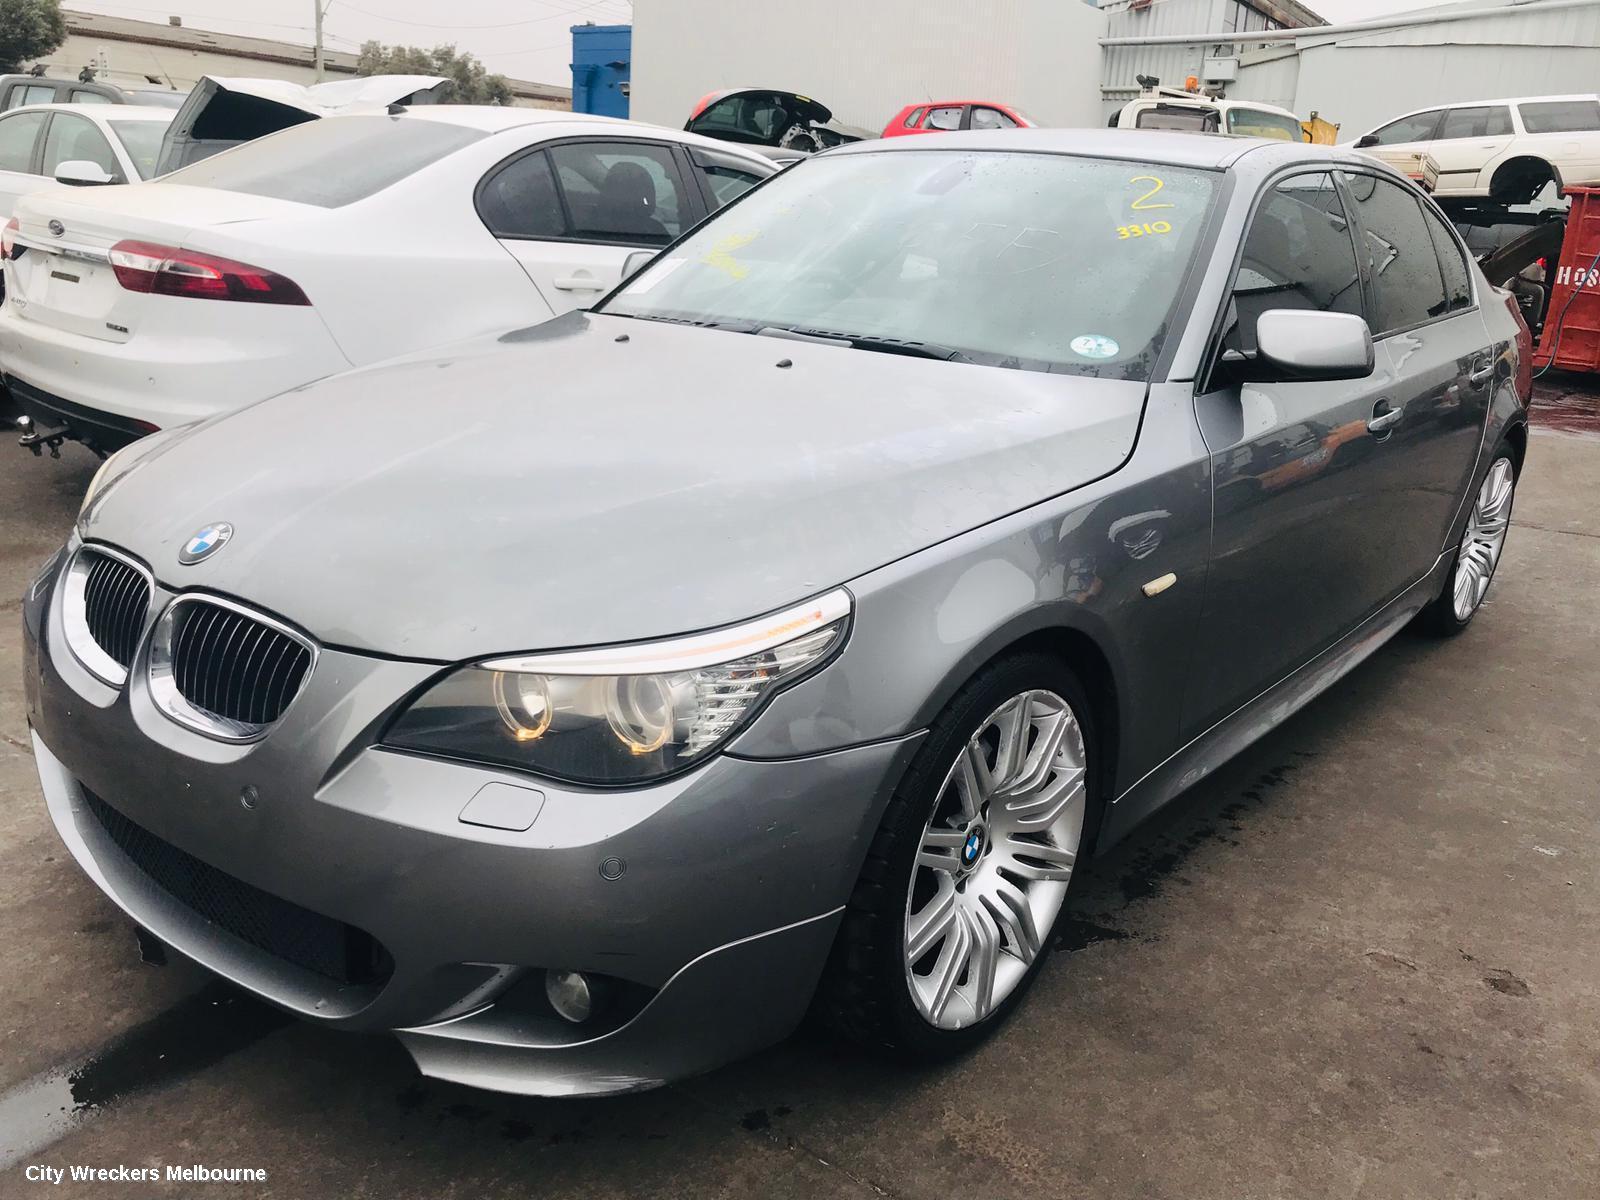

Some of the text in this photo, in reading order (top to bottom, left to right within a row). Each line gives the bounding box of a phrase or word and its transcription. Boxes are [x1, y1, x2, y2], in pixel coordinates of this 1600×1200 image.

[1129, 176, 1175, 209] 2
[1116, 221, 1171, 240] 3310
[1557, 266, 1600, 287] HOS
